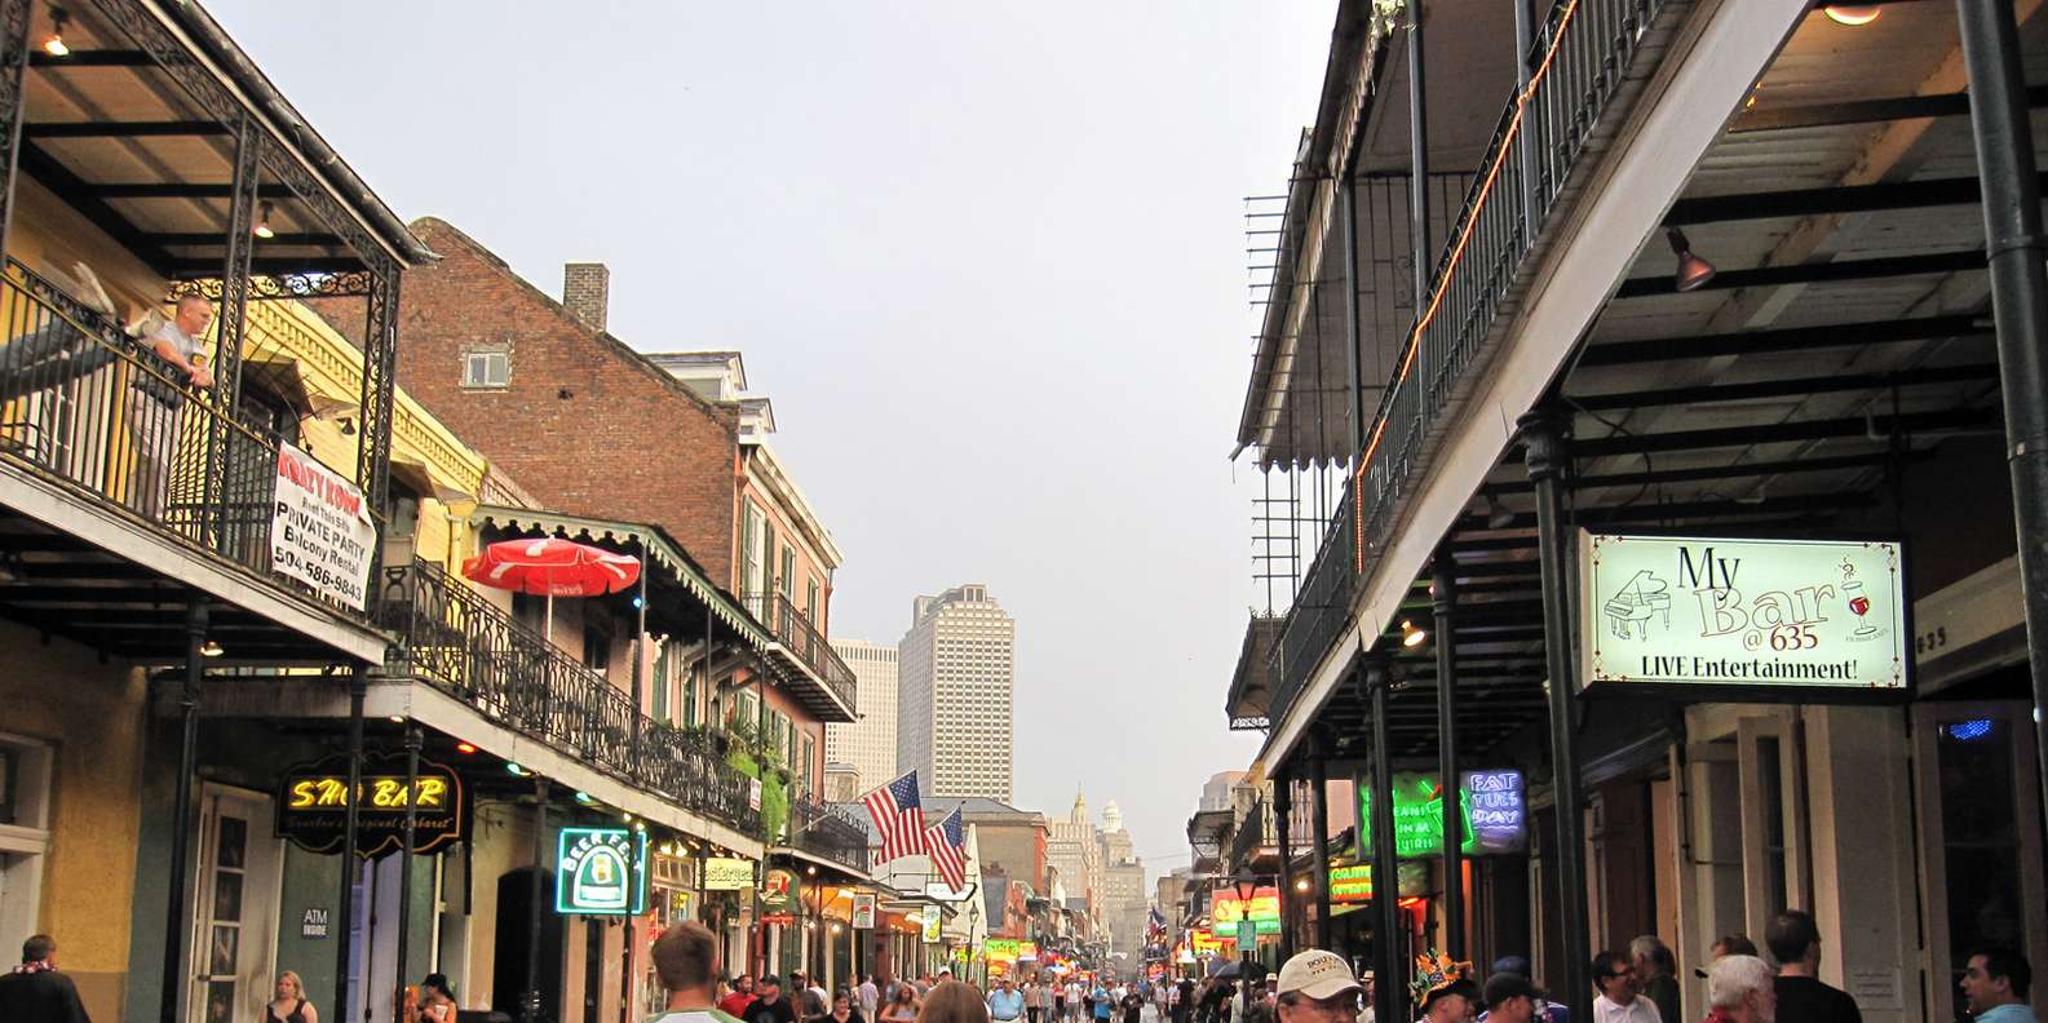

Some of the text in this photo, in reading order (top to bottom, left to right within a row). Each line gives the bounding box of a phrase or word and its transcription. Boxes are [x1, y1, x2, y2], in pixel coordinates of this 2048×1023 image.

[276, 500, 366, 562] PRIVATE PARTY
[284, 526, 359, 576] Balcony Rental
[1678, 546, 1741, 601] My
[1694, 582, 1836, 637] Bar
[1743, 629, 1763, 651] @
[1770, 624, 1819, 651] 635
[1641, 655, 1858, 680] LIVE Entertainment!
[373, 779, 447, 807] BAR
[1470, 773, 1519, 791] FAT
[1473, 791, 1519, 808] TUES
[1472, 810, 1519, 825] DAY
[562, 831, 603, 872] BEER
[304, 909, 328, 924] ATM
